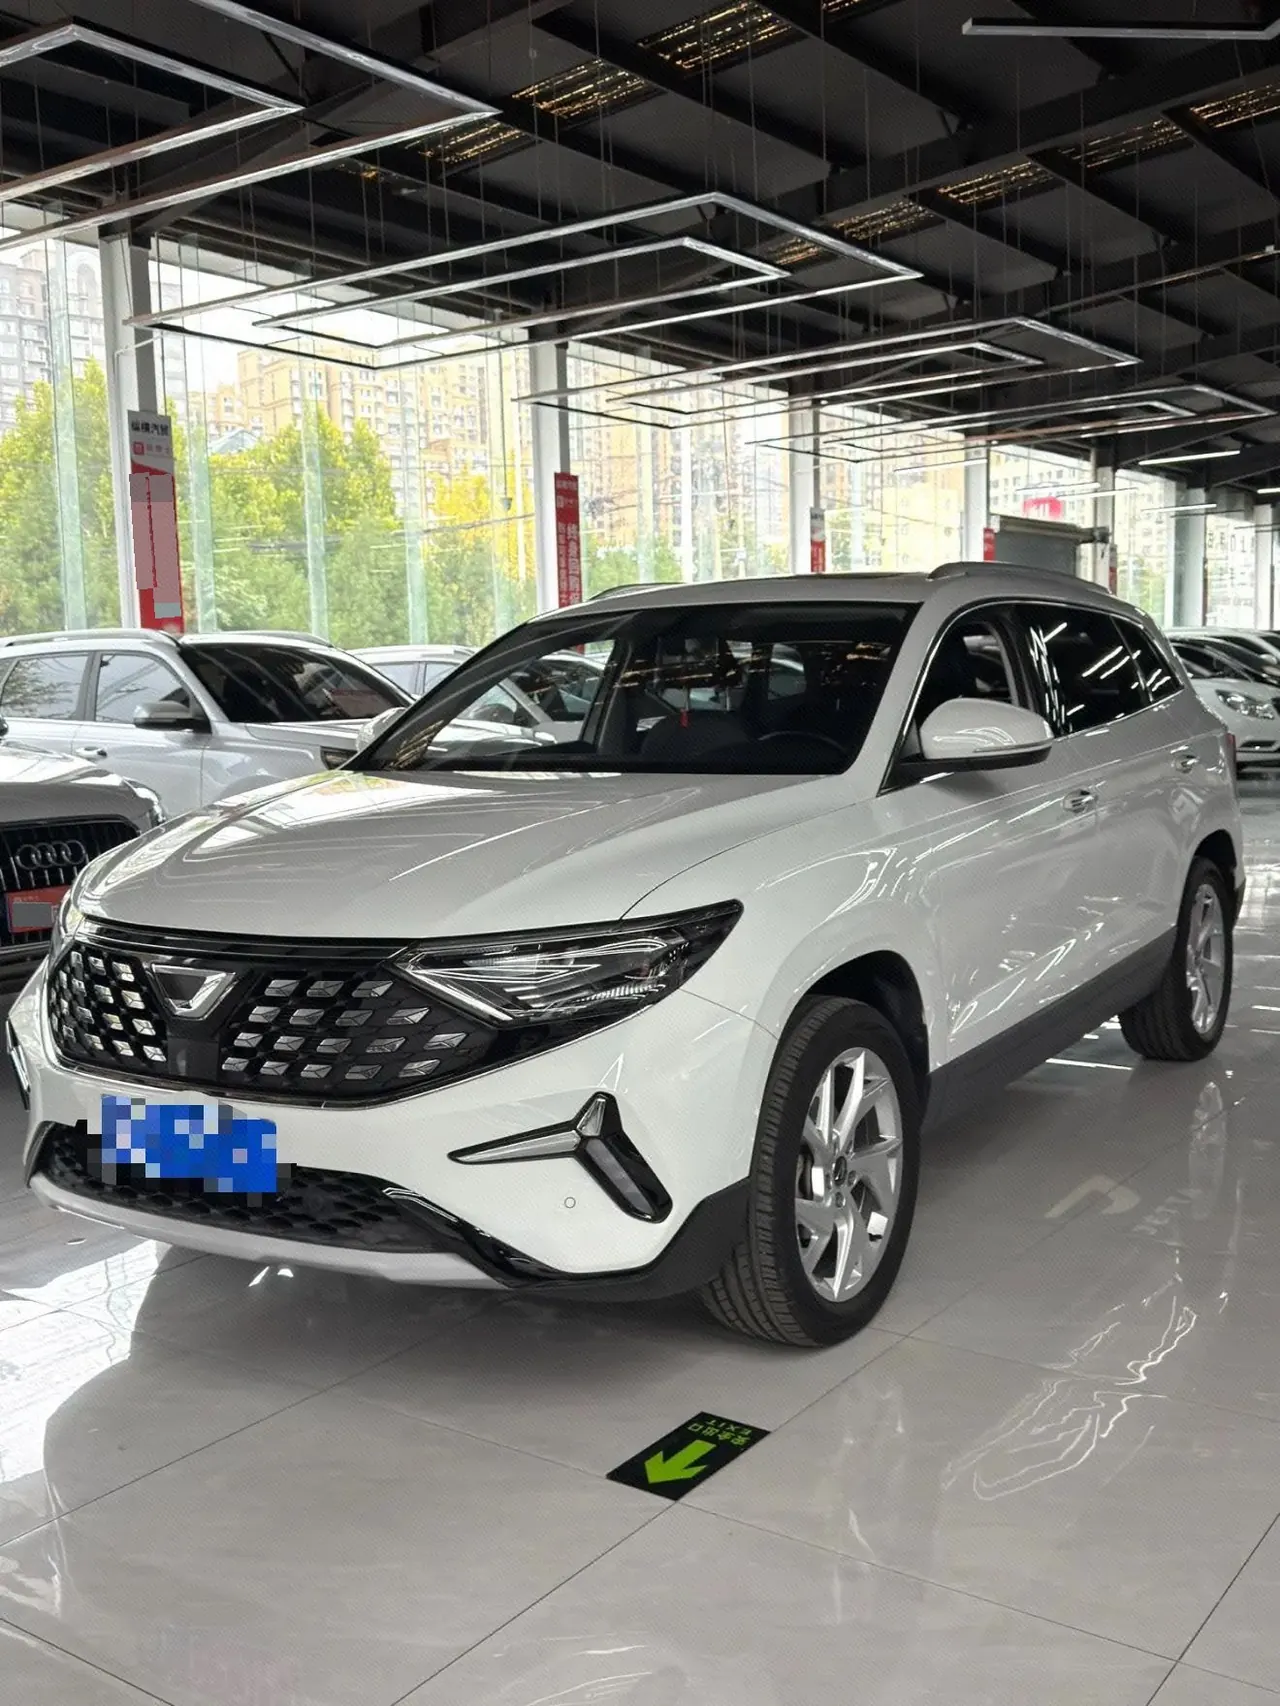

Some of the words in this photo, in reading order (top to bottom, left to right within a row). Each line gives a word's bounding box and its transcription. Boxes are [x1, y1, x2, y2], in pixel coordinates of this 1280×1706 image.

[687, 1423, 751, 1446] 安全出口
[706, 1419, 752, 1436] EXIT
